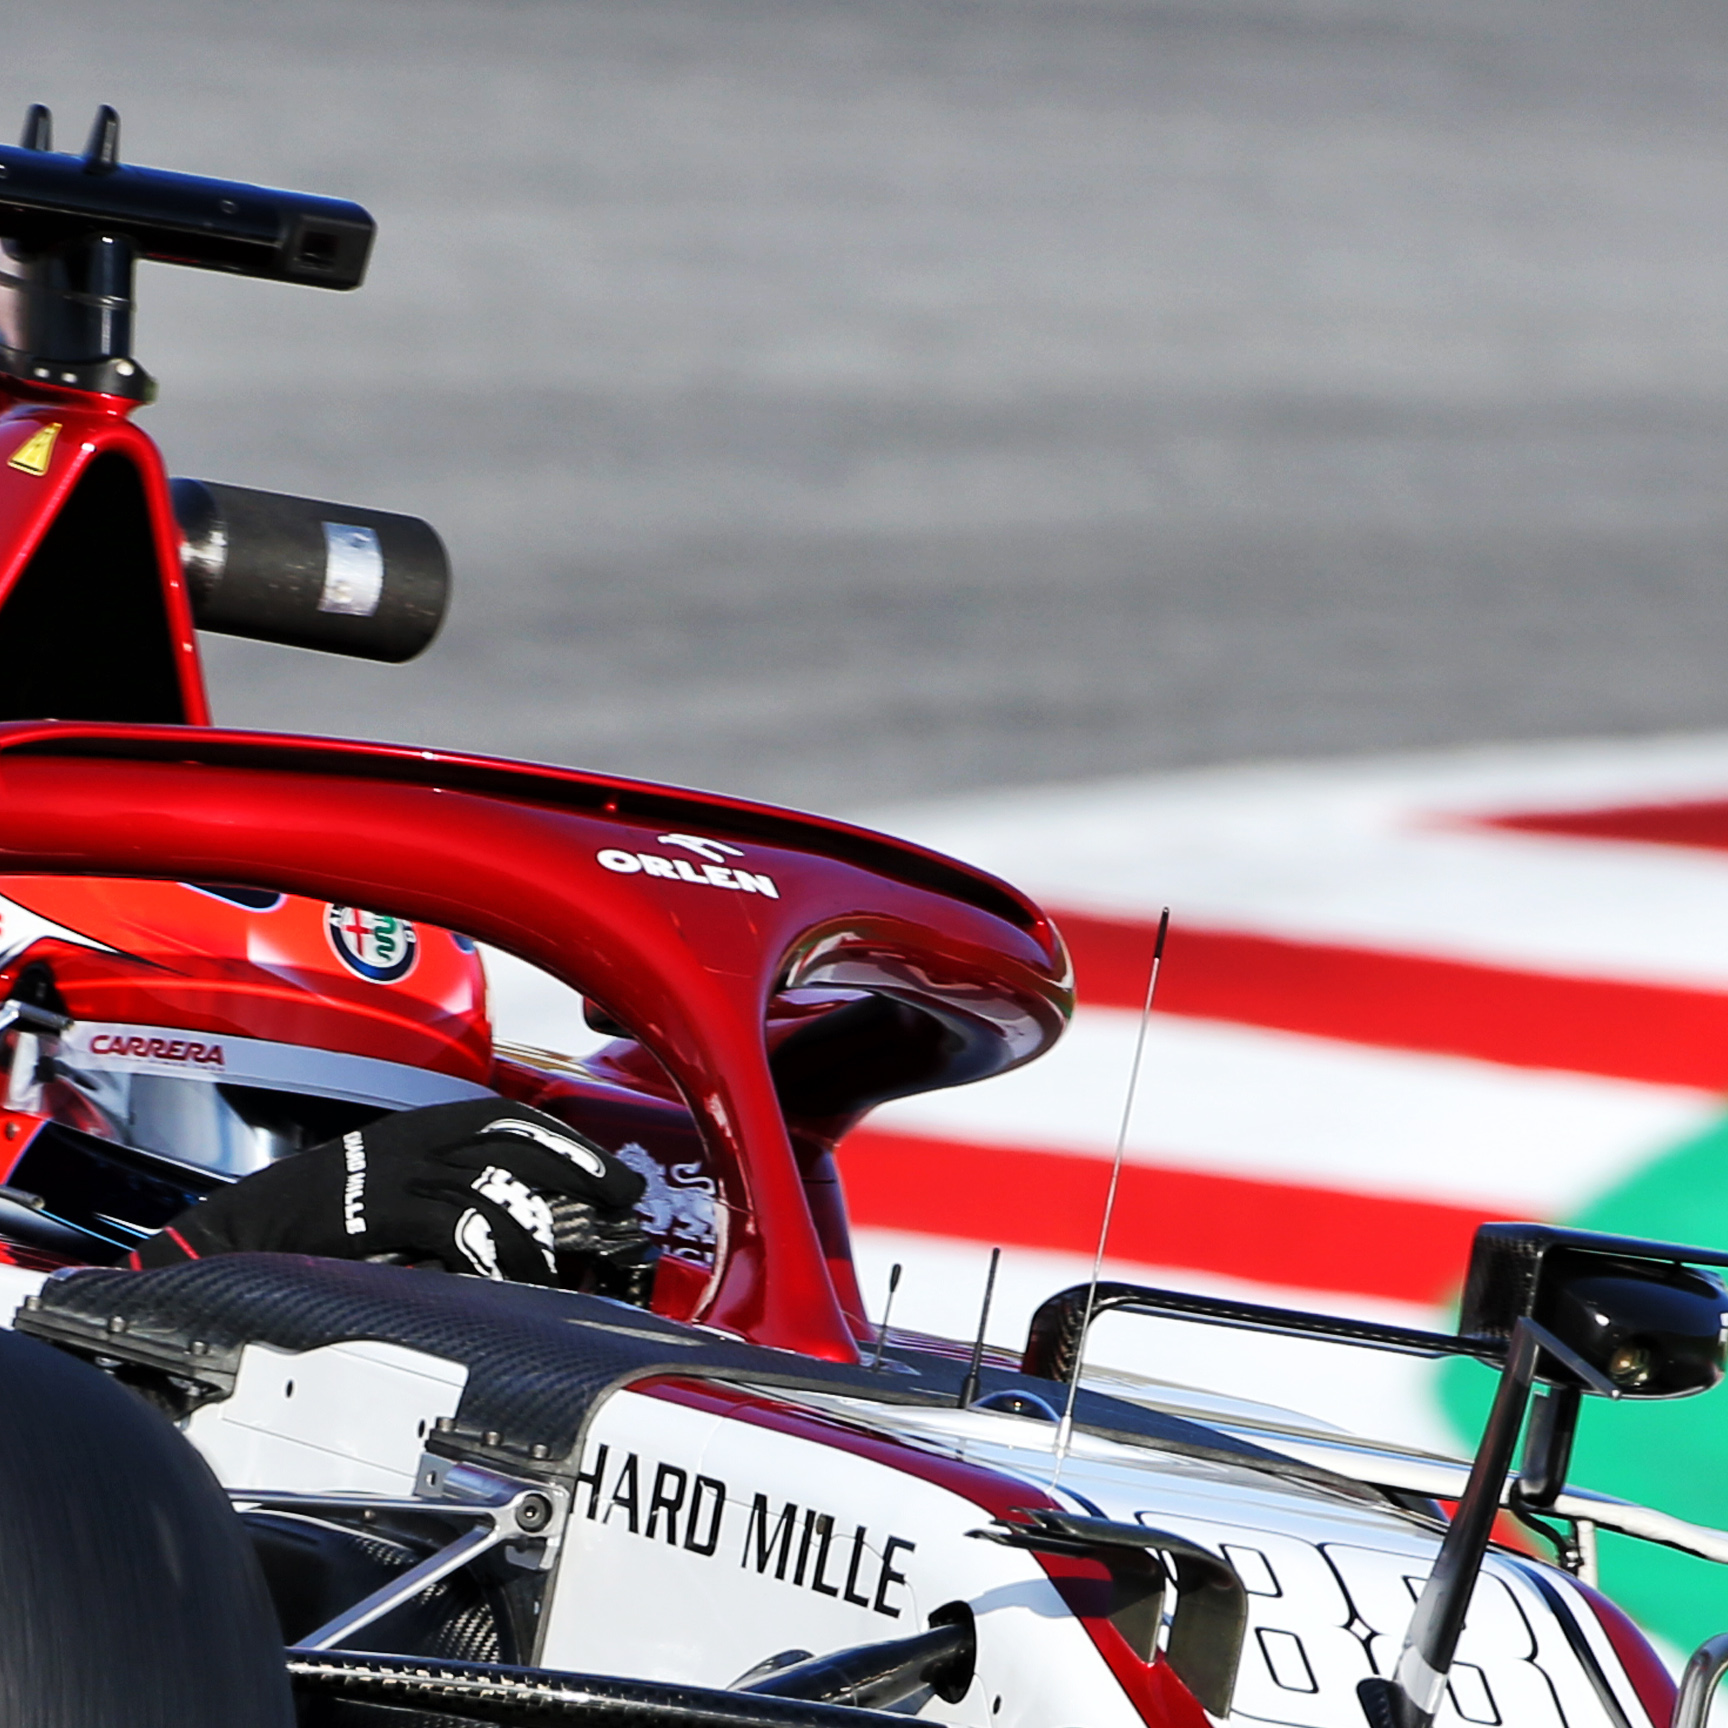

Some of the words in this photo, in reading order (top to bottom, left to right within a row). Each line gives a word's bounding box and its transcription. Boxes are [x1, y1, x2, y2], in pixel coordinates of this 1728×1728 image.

[597, 850, 780, 899] ORLEN
[90, 1034, 226, 1065] CARRERA
[741, 1492, 916, 1619] MILLE
